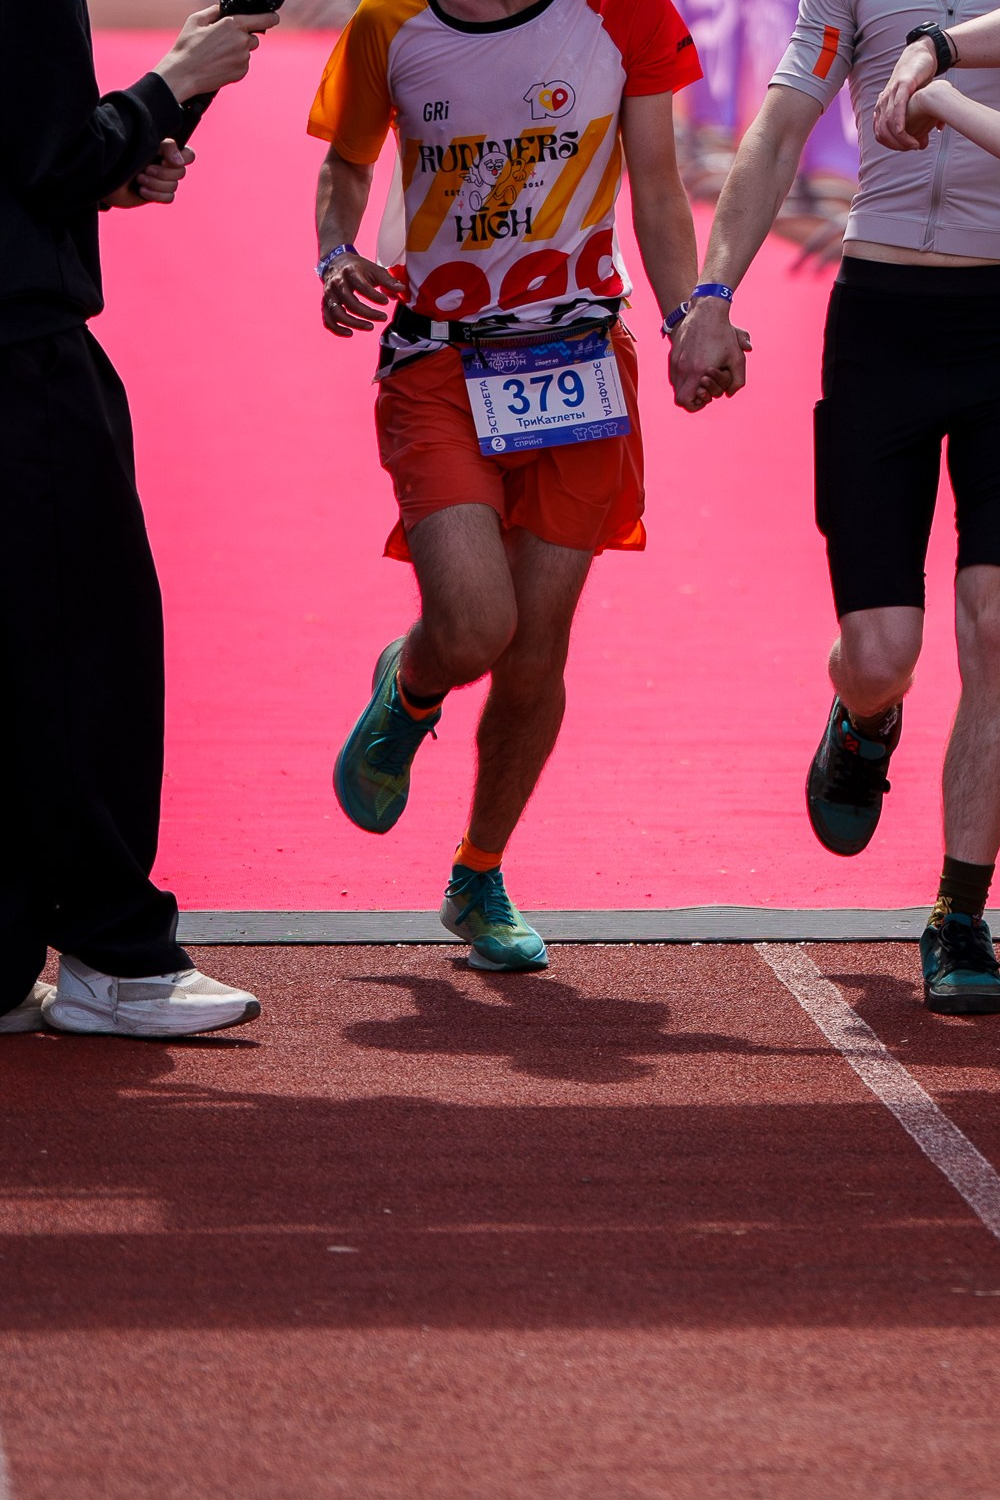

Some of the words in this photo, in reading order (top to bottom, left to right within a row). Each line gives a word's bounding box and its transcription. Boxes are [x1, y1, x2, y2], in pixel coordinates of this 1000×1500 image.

[418, 130, 579, 173] RUNNERS
[454, 206, 532, 242] HIGH
[479, 380, 499, 434] ЭСТАФЕТА
[502, 369, 585, 415] 379
[593, 361, 612, 417] ЭСТАФЕТА
[516, 411, 585, 429] ТриКатлеты
[494, 438, 502, 447] 2
[514, 438, 543, 447] СПРИНТ
